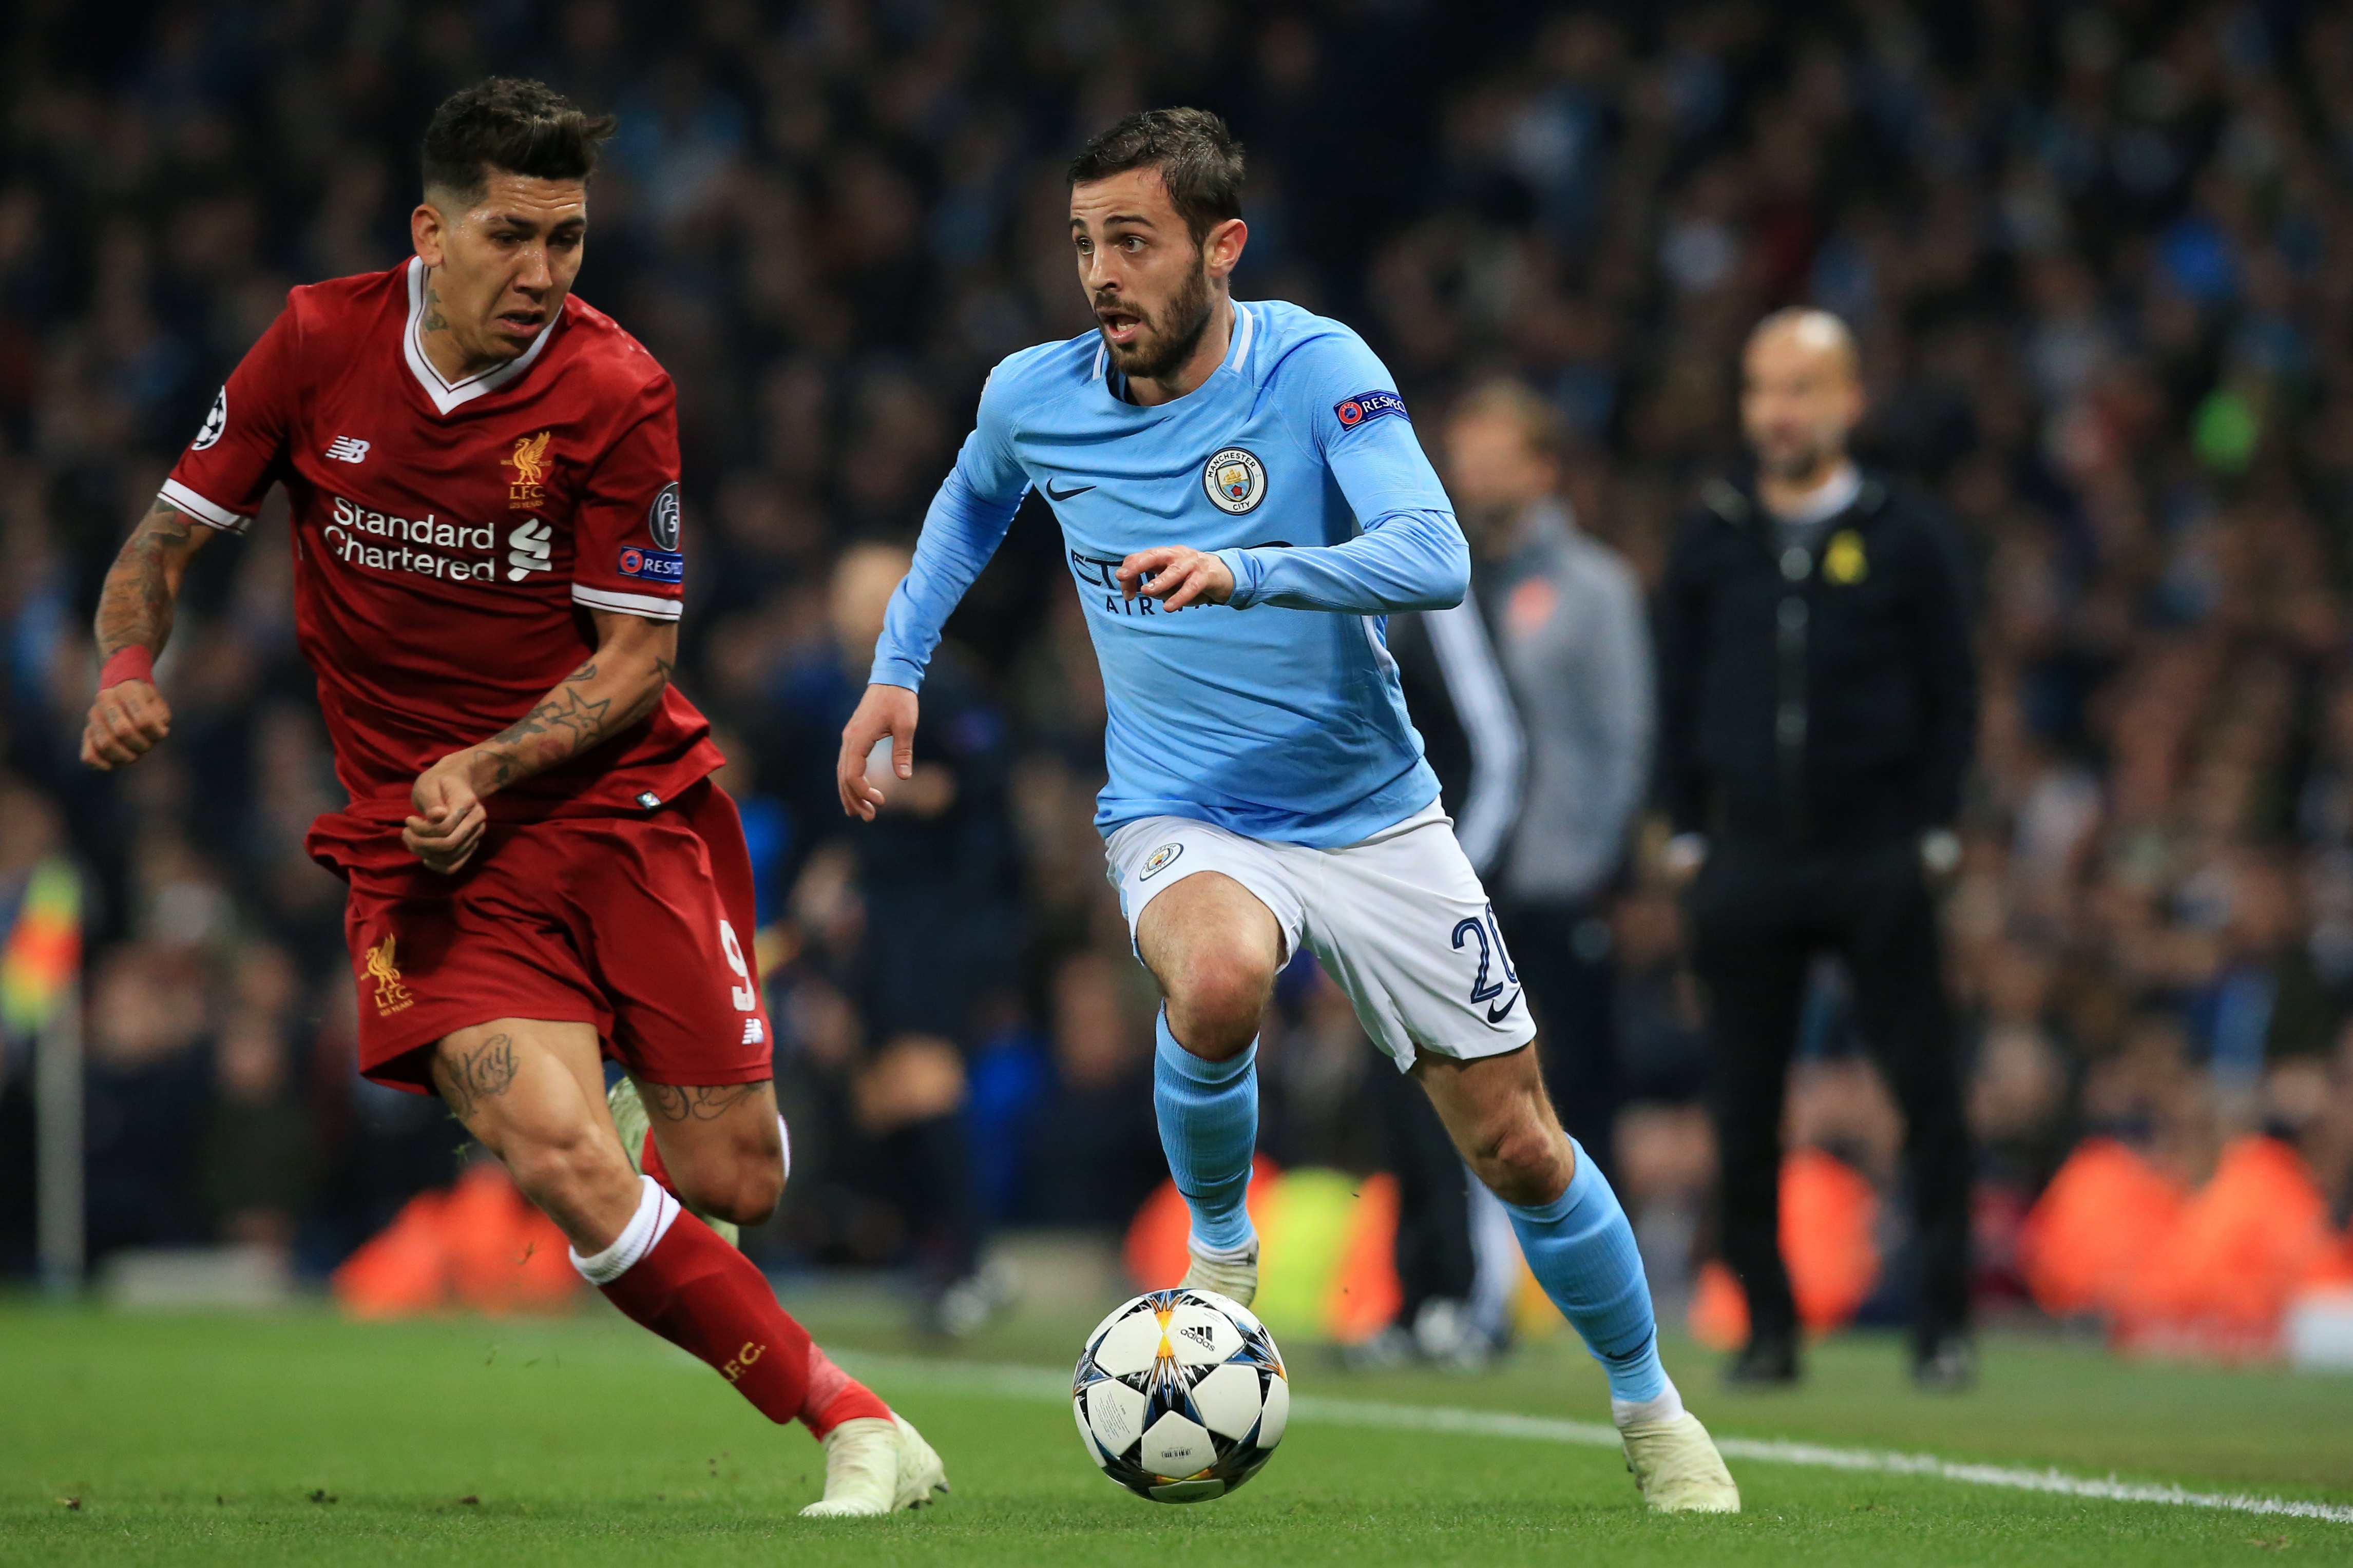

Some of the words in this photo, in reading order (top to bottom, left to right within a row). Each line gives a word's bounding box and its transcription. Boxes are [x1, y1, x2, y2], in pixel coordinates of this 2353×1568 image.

[1208, 453, 1256, 477] MANCHESTER
[333, 497, 494, 549] Standard
[1233, 501, 1250, 510] CITY
[324, 525, 494, 582] Chartered
[720, 919, 756, 1011] 9
[1180, 1329, 1215, 1351] adidas
